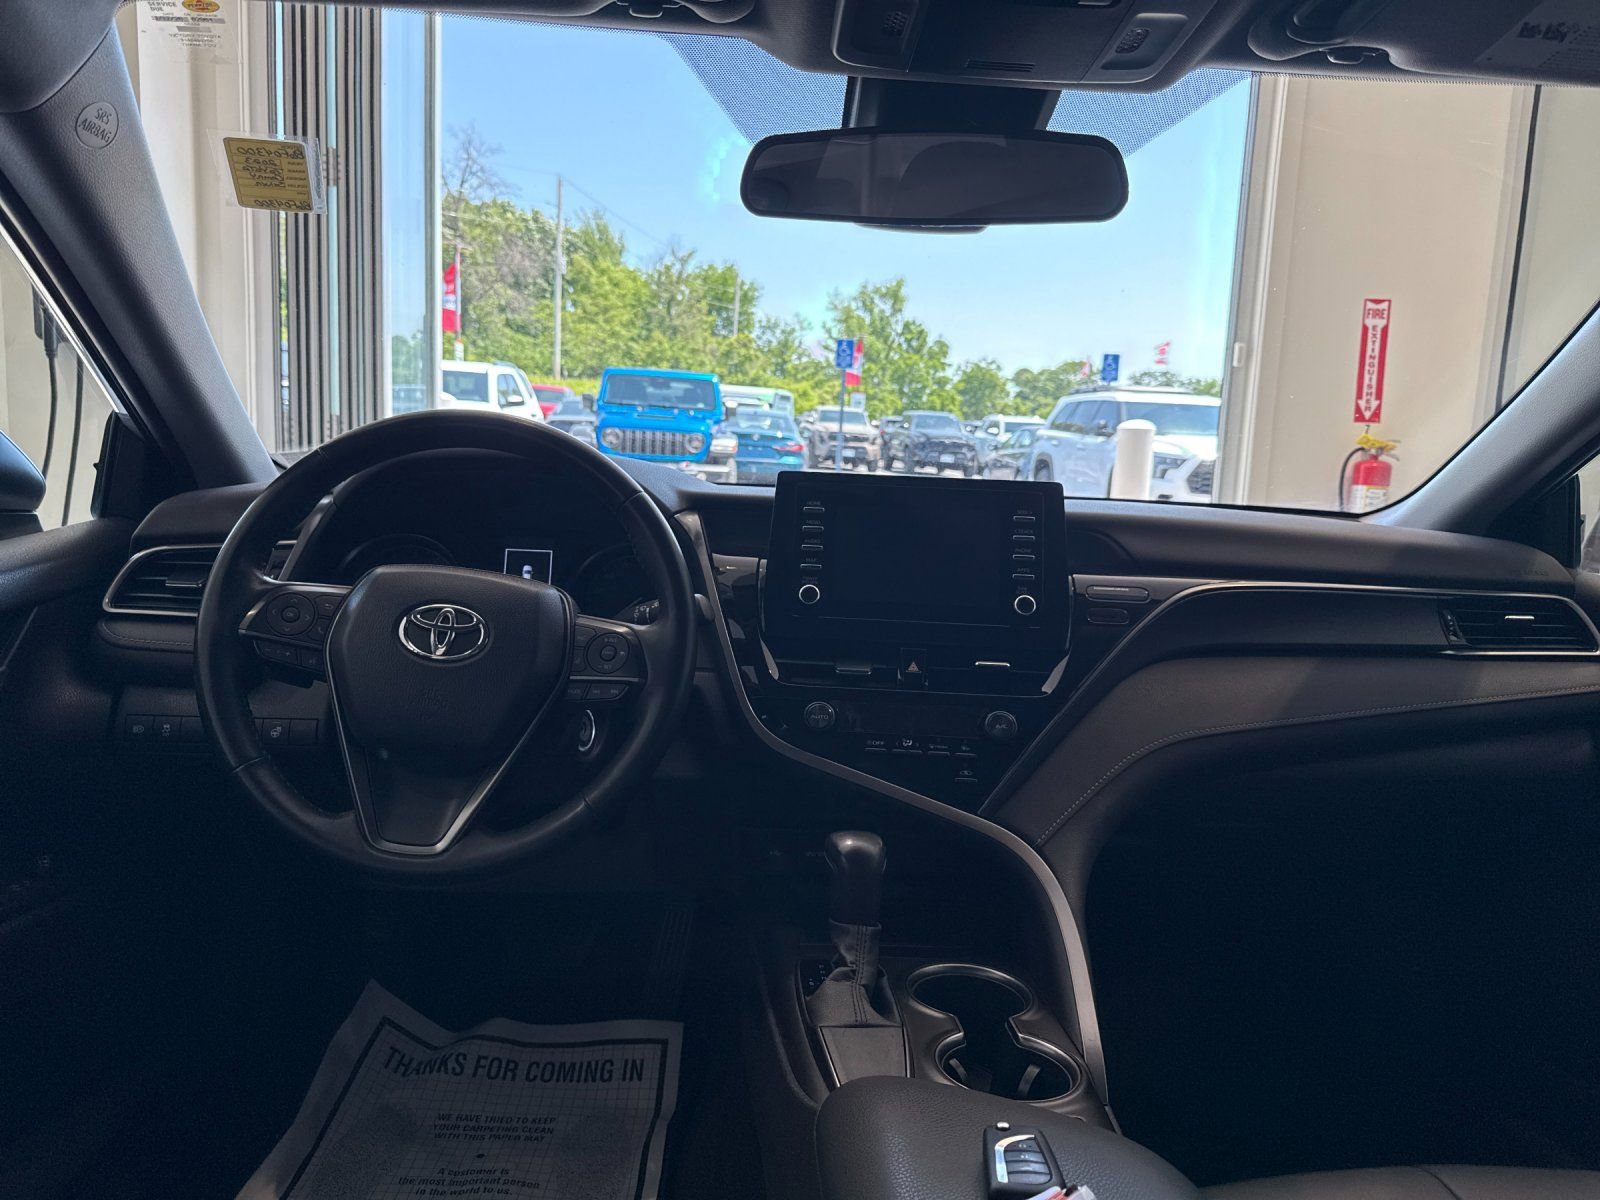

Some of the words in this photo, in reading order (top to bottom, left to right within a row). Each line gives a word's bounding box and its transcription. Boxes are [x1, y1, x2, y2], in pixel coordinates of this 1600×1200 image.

[95, 107, 112, 125] SRS
[78, 118, 112, 143] AIRBAG
[1366, 308, 1386, 320] FIRE
[1364, 324, 1379, 412] EXTINGUISHER
[384, 1046, 468, 1078] THANKS
[472, 1055, 520, 1082] FOR
[525, 1060, 615, 1084] COMING
[622, 1058, 645, 1082] IN
[438, 1113, 454, 1122] WE
[455, 1113, 481, 1123] HAVE
[484, 1115, 513, 1124] TRIED
[515, 1116, 529, 1125] TO
[530, 1117, 556, 1125] KEEP
[433, 1123, 460, 1132] YOUR
[462, 1124, 519, 1133] CARPETING
[522, 1126, 555, 1135] CLEAN
[433, 1132, 460, 1140] WITH
[463, 1133, 486, 1141] THIS
[488, 1134, 521, 1142] PAPER
[523, 1135, 546, 1143] MAT
[437, 1167, 446, 1176] A
[447, 1167, 498, 1177] customer
[499, 1167, 510, 1175] is
[398, 1176, 416, 1185] the
[417, 1177, 447, 1186] most
[449, 1176, 502, 1187] important
[502, 1178, 540, 1189] person
[428, 1187, 447, 1196] the
[449, 1186, 481, 1196] world
[482, 1186, 494, 1195] to
[496, 1187, 512, 1196] us.
